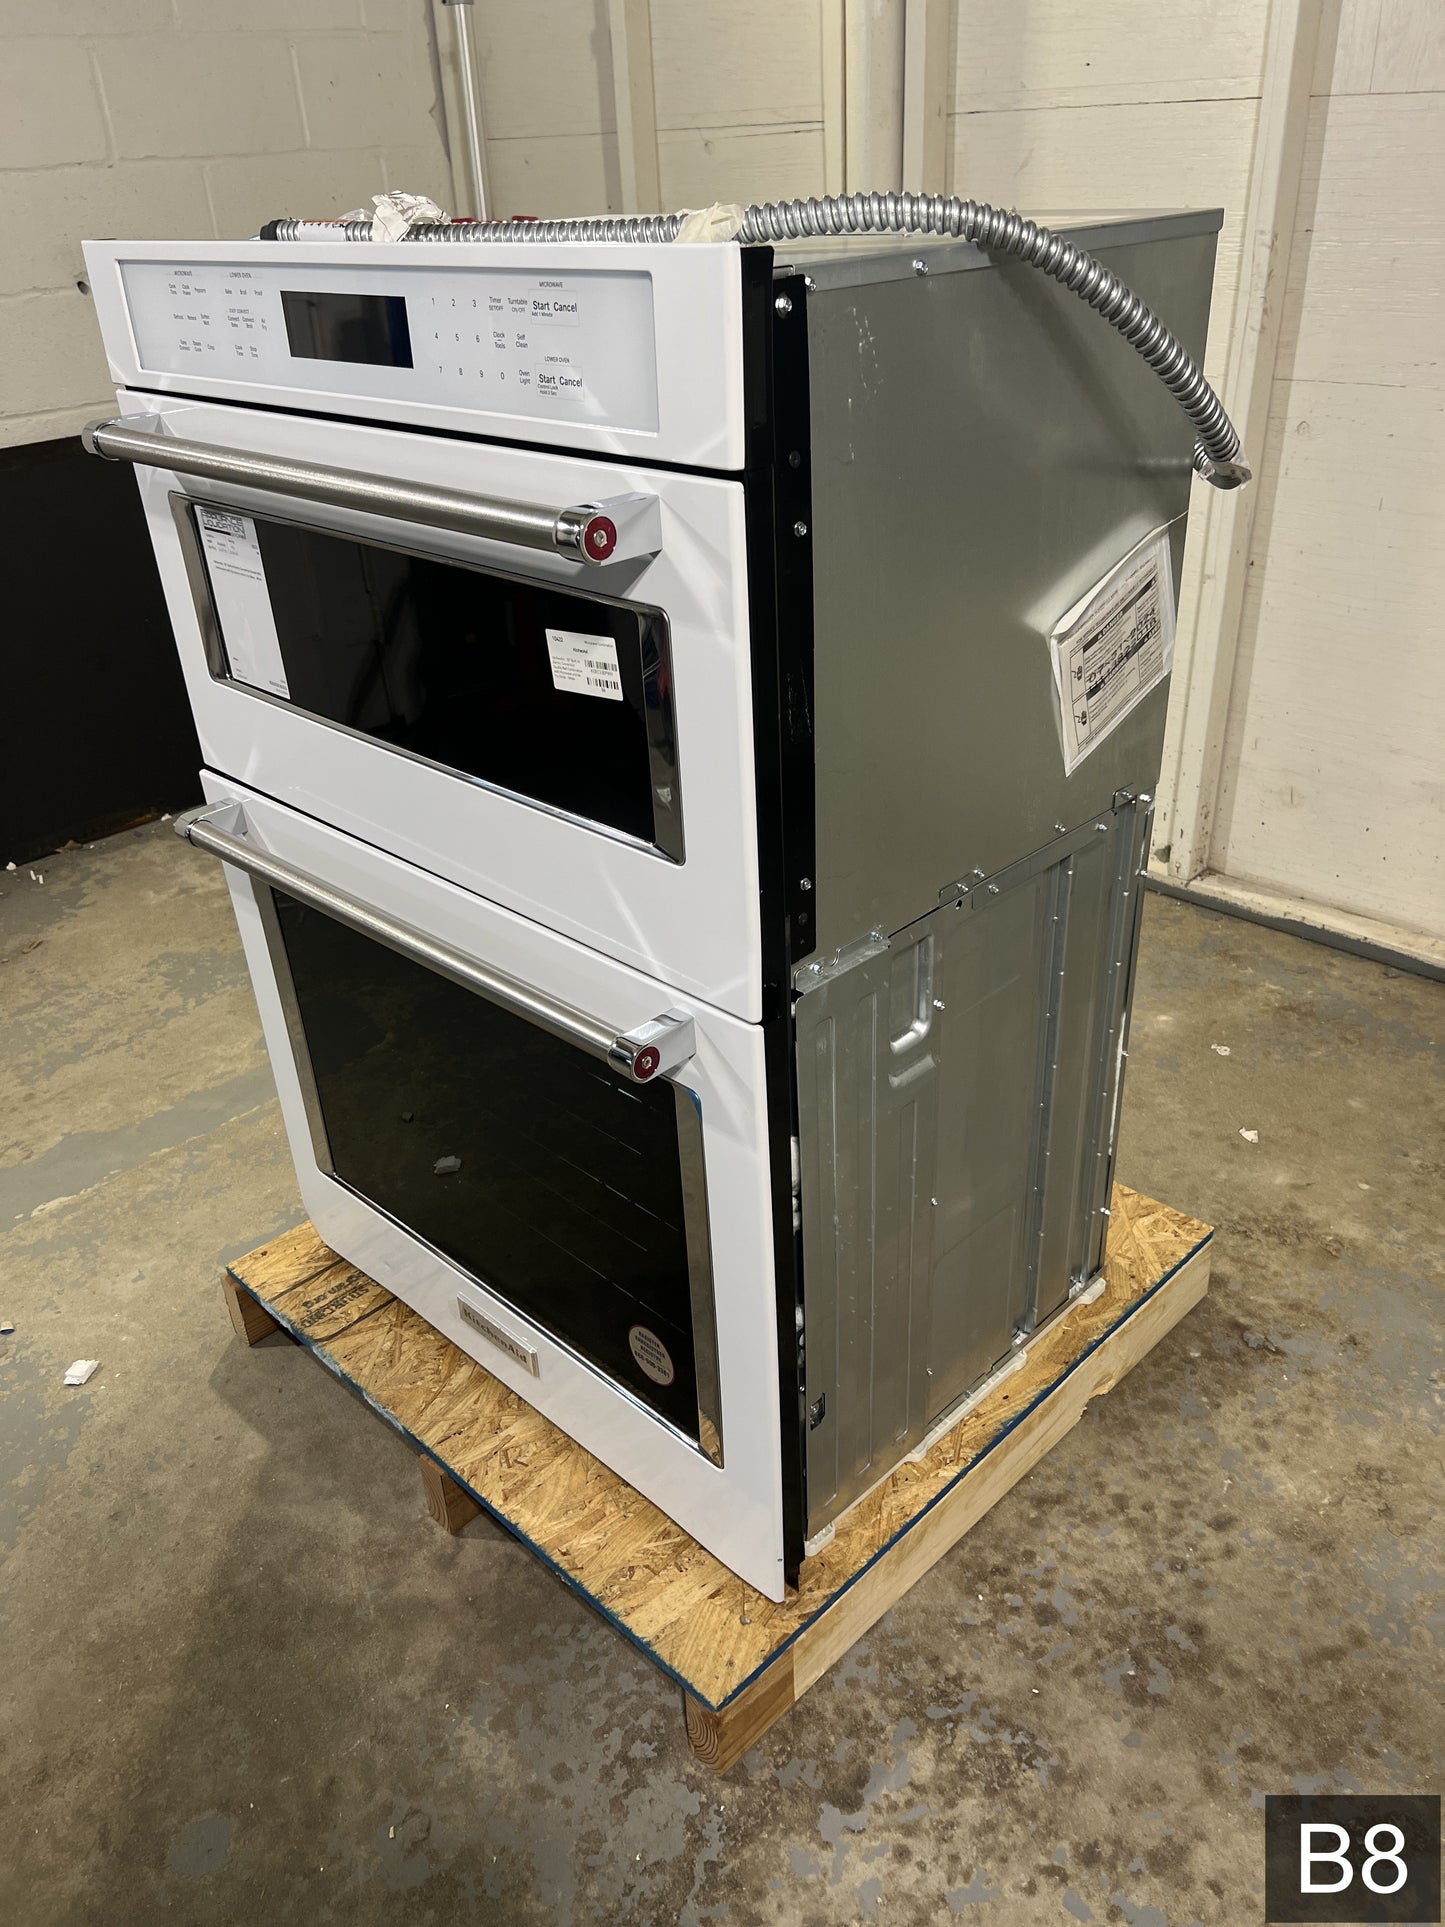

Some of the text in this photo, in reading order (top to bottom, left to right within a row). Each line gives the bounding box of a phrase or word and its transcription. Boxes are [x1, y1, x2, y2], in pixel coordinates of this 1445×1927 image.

[451, 298, 456, 307] 2
[472, 299, 477, 308] 3
[489, 296, 502, 304] Timer
[507, 297, 528, 306] Turntable
[532, 300, 578, 313] Start Cancel
[434, 331, 480, 343] 4 5 6
[492, 330, 505, 339] Clock
[516, 333, 526, 341] Self
[494, 341, 506, 350] Tools
[515, 341, 529, 349] Clean
[438, 365, 505, 380] 7 8 9 0
[518, 369, 531, 377] Oven
[519, 377, 531, 385] Light
[538, 373, 583, 388] Start Cancel
[463, 1307, 528, 1364] KitchenAid
